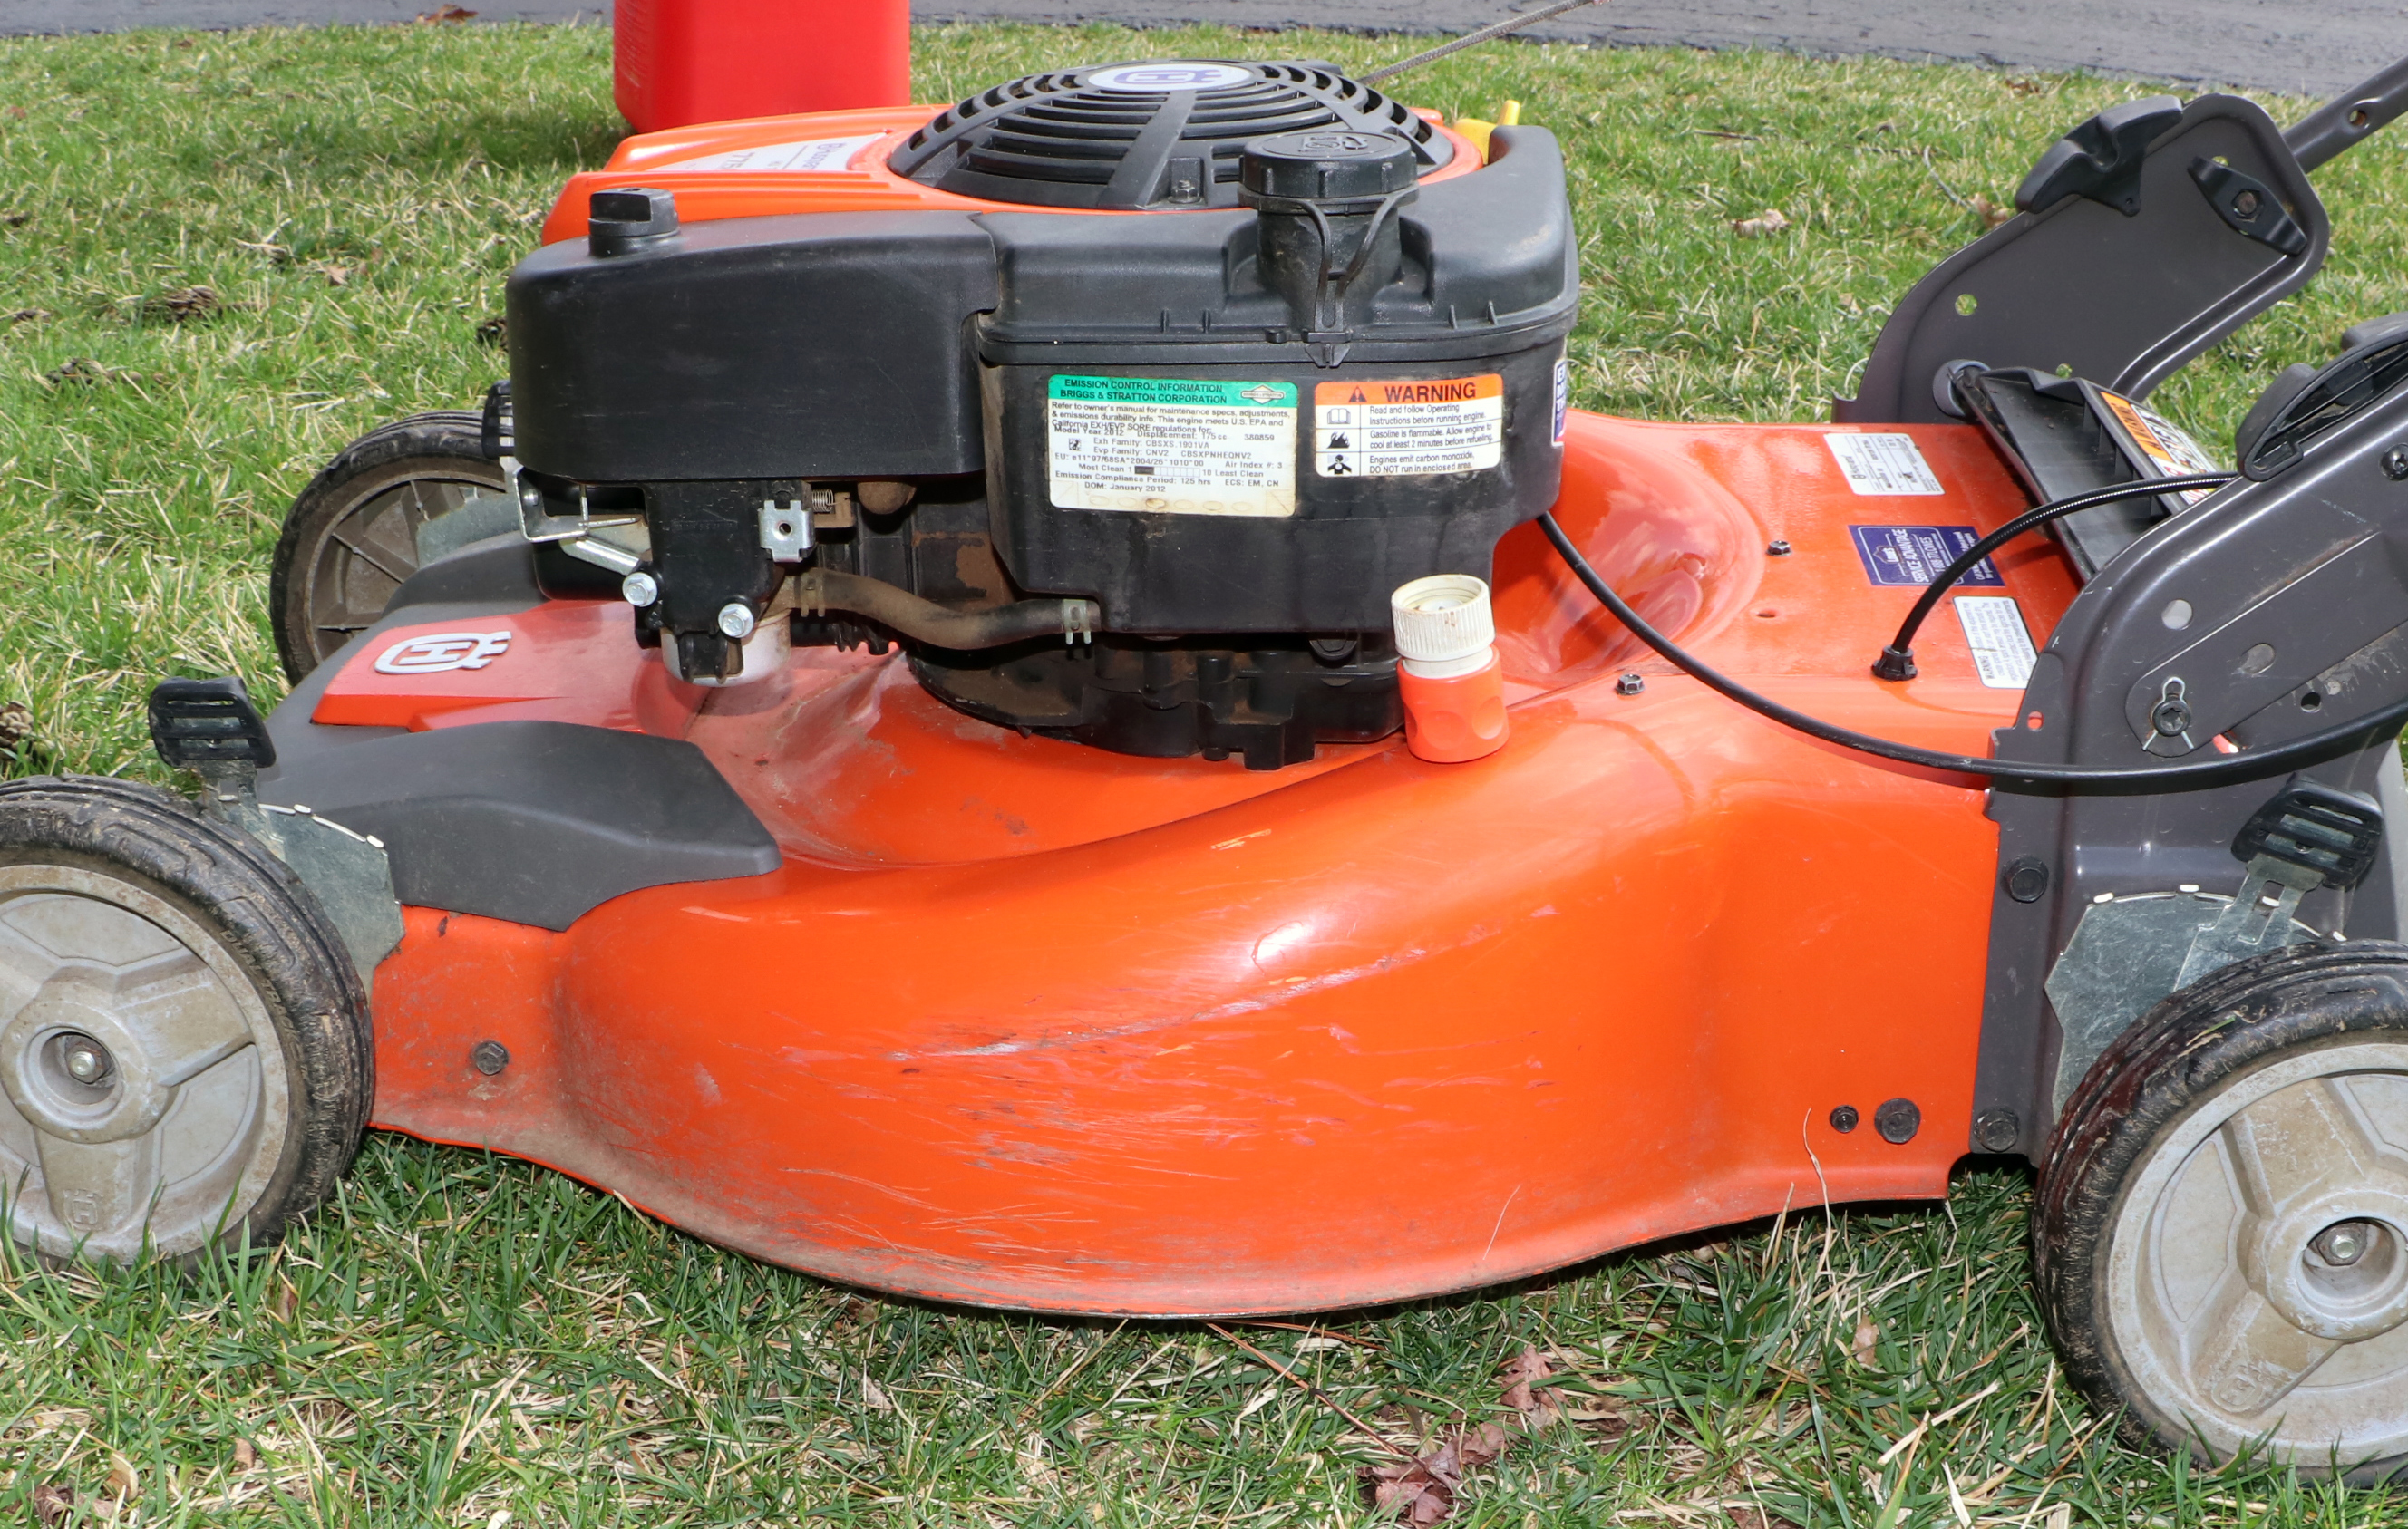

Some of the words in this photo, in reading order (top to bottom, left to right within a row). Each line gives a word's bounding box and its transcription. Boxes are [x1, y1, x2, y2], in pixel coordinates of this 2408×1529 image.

[1064, 379, 1108, 389] EMISSION
[1111, 381, 1155, 391] CONTROL
[1158, 382, 1222, 392] INFORMATION
[1060, 389, 1095, 399] BRIGGS
[1106, 392, 1156, 402] STRATTON
[1158, 393, 1227, 403] CORPORATION
[1384, 382, 1476, 402] WARNING
[1116, 405, 1145, 413] manual
[1160, 407, 1209, 415] maintenance
[1369, 405, 1387, 414] Read
[1389, 405, 1402, 413] and
[1403, 404, 1424, 413] follow
[1426, 403, 1460, 414] Operating
[1060, 411, 1099, 420] emissions
[1101, 413, 1136, 422] durability
[1158, 415, 1175, 423] This
[1177, 417, 1203, 425] engine
[1205, 417, 1229, 425] meets
[1231, 418, 1247, 426] U.S.
[1369, 416, 1411, 425] Instructions
[1413, 414, 1434, 424] before
[1436, 414, 1461, 424] running
[1052, 419, 1088, 428] California
[1127, 422, 1151, 431] SORE
[1152, 424, 1197, 433] regulations
[1054, 424, 1080, 433] Model
[1083, 426, 1102, 435] Year
[1370, 429, 1399, 439] Gasoline
[1401, 429, 1407, 438] is
[1446, 426, 1464, 436] Allow
[1465, 425, 1485, 435] engine
[1093, 437, 1109, 445] Exh
[1112, 438, 1142, 447] Family:
[1370, 440, 1385, 449] cool
[1386, 440, 1393, 449] at
[1393, 440, 1410, 449] least
[1417, 439, 1443, 448] minutes
[1445, 437, 1465, 447] before
[1093, 446, 1109, 455] Evp
[1112, 447, 1143, 456] Family:
[1145, 449, 1169, 457] CNV2
[1054, 452, 1069, 460] EU:
[1225, 460, 1237, 469] Air
[1370, 455, 1397, 465] Engines
[1399, 454, 1414, 463] emit
[1416, 453, 1440, 463] carbon
[1078, 463, 1099, 471] Most
[1369, 465, 1382, 474] DO
[1383, 465, 1399, 474] NOT
[1401, 465, 1413, 473] run
[1414, 464, 1421, 472] in
[1422, 462, 1455, 472] enclosed
[1055, 470, 1092, 479] Emission
[1095, 473, 1143, 482] Compliance
[1147, 476, 1177, 484] Period:
[1084, 481, 1107, 489] DOM:
[1110, 483, 1142, 492] January
